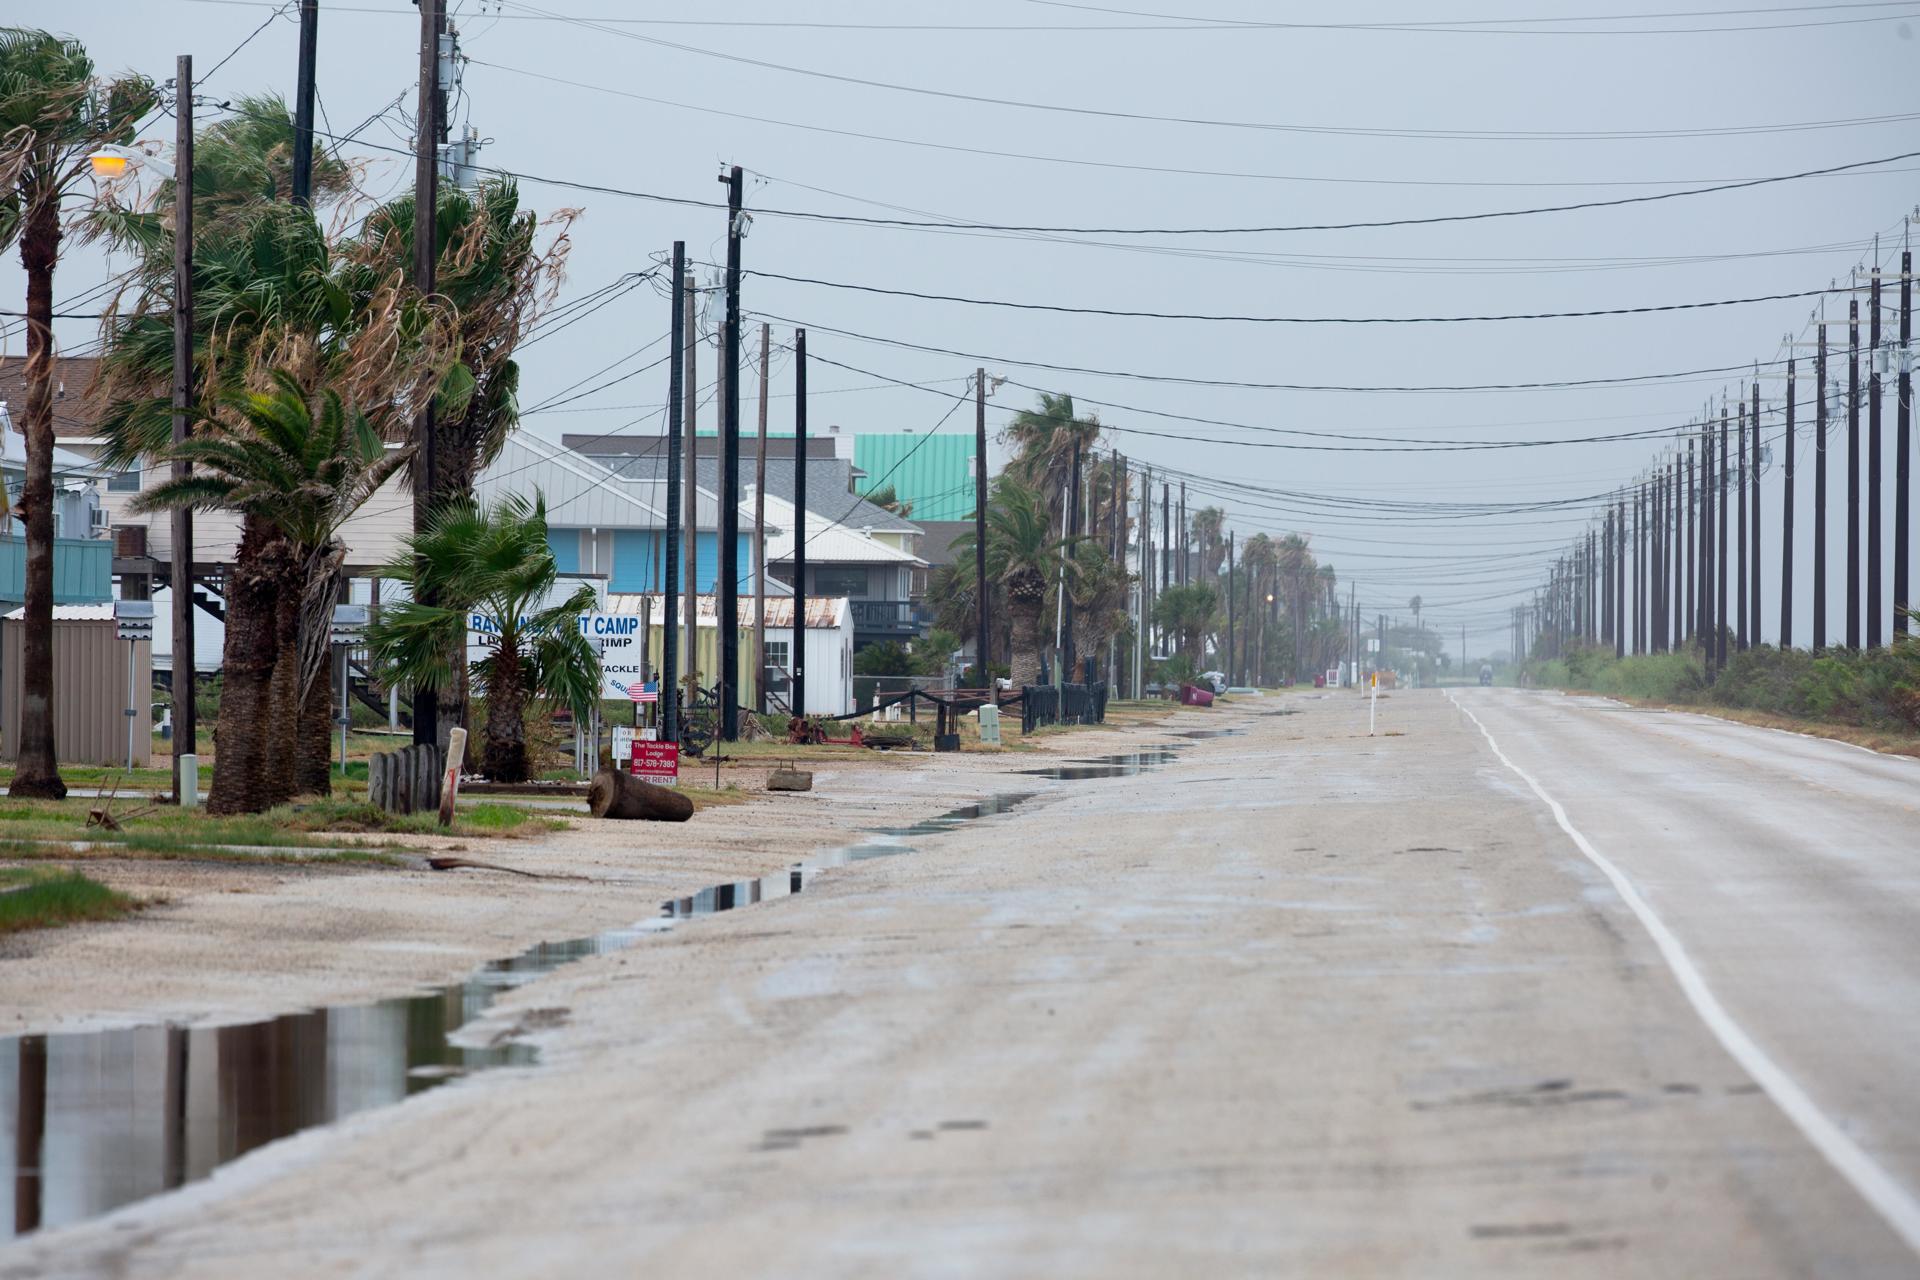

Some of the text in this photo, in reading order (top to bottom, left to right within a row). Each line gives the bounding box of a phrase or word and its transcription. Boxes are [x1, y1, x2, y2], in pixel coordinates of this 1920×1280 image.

[594, 616, 639, 635] CAMP
[601, 665, 639, 673] TACKLE
[645, 750, 664, 758] Lodge
[652, 776, 673, 784] RENT
